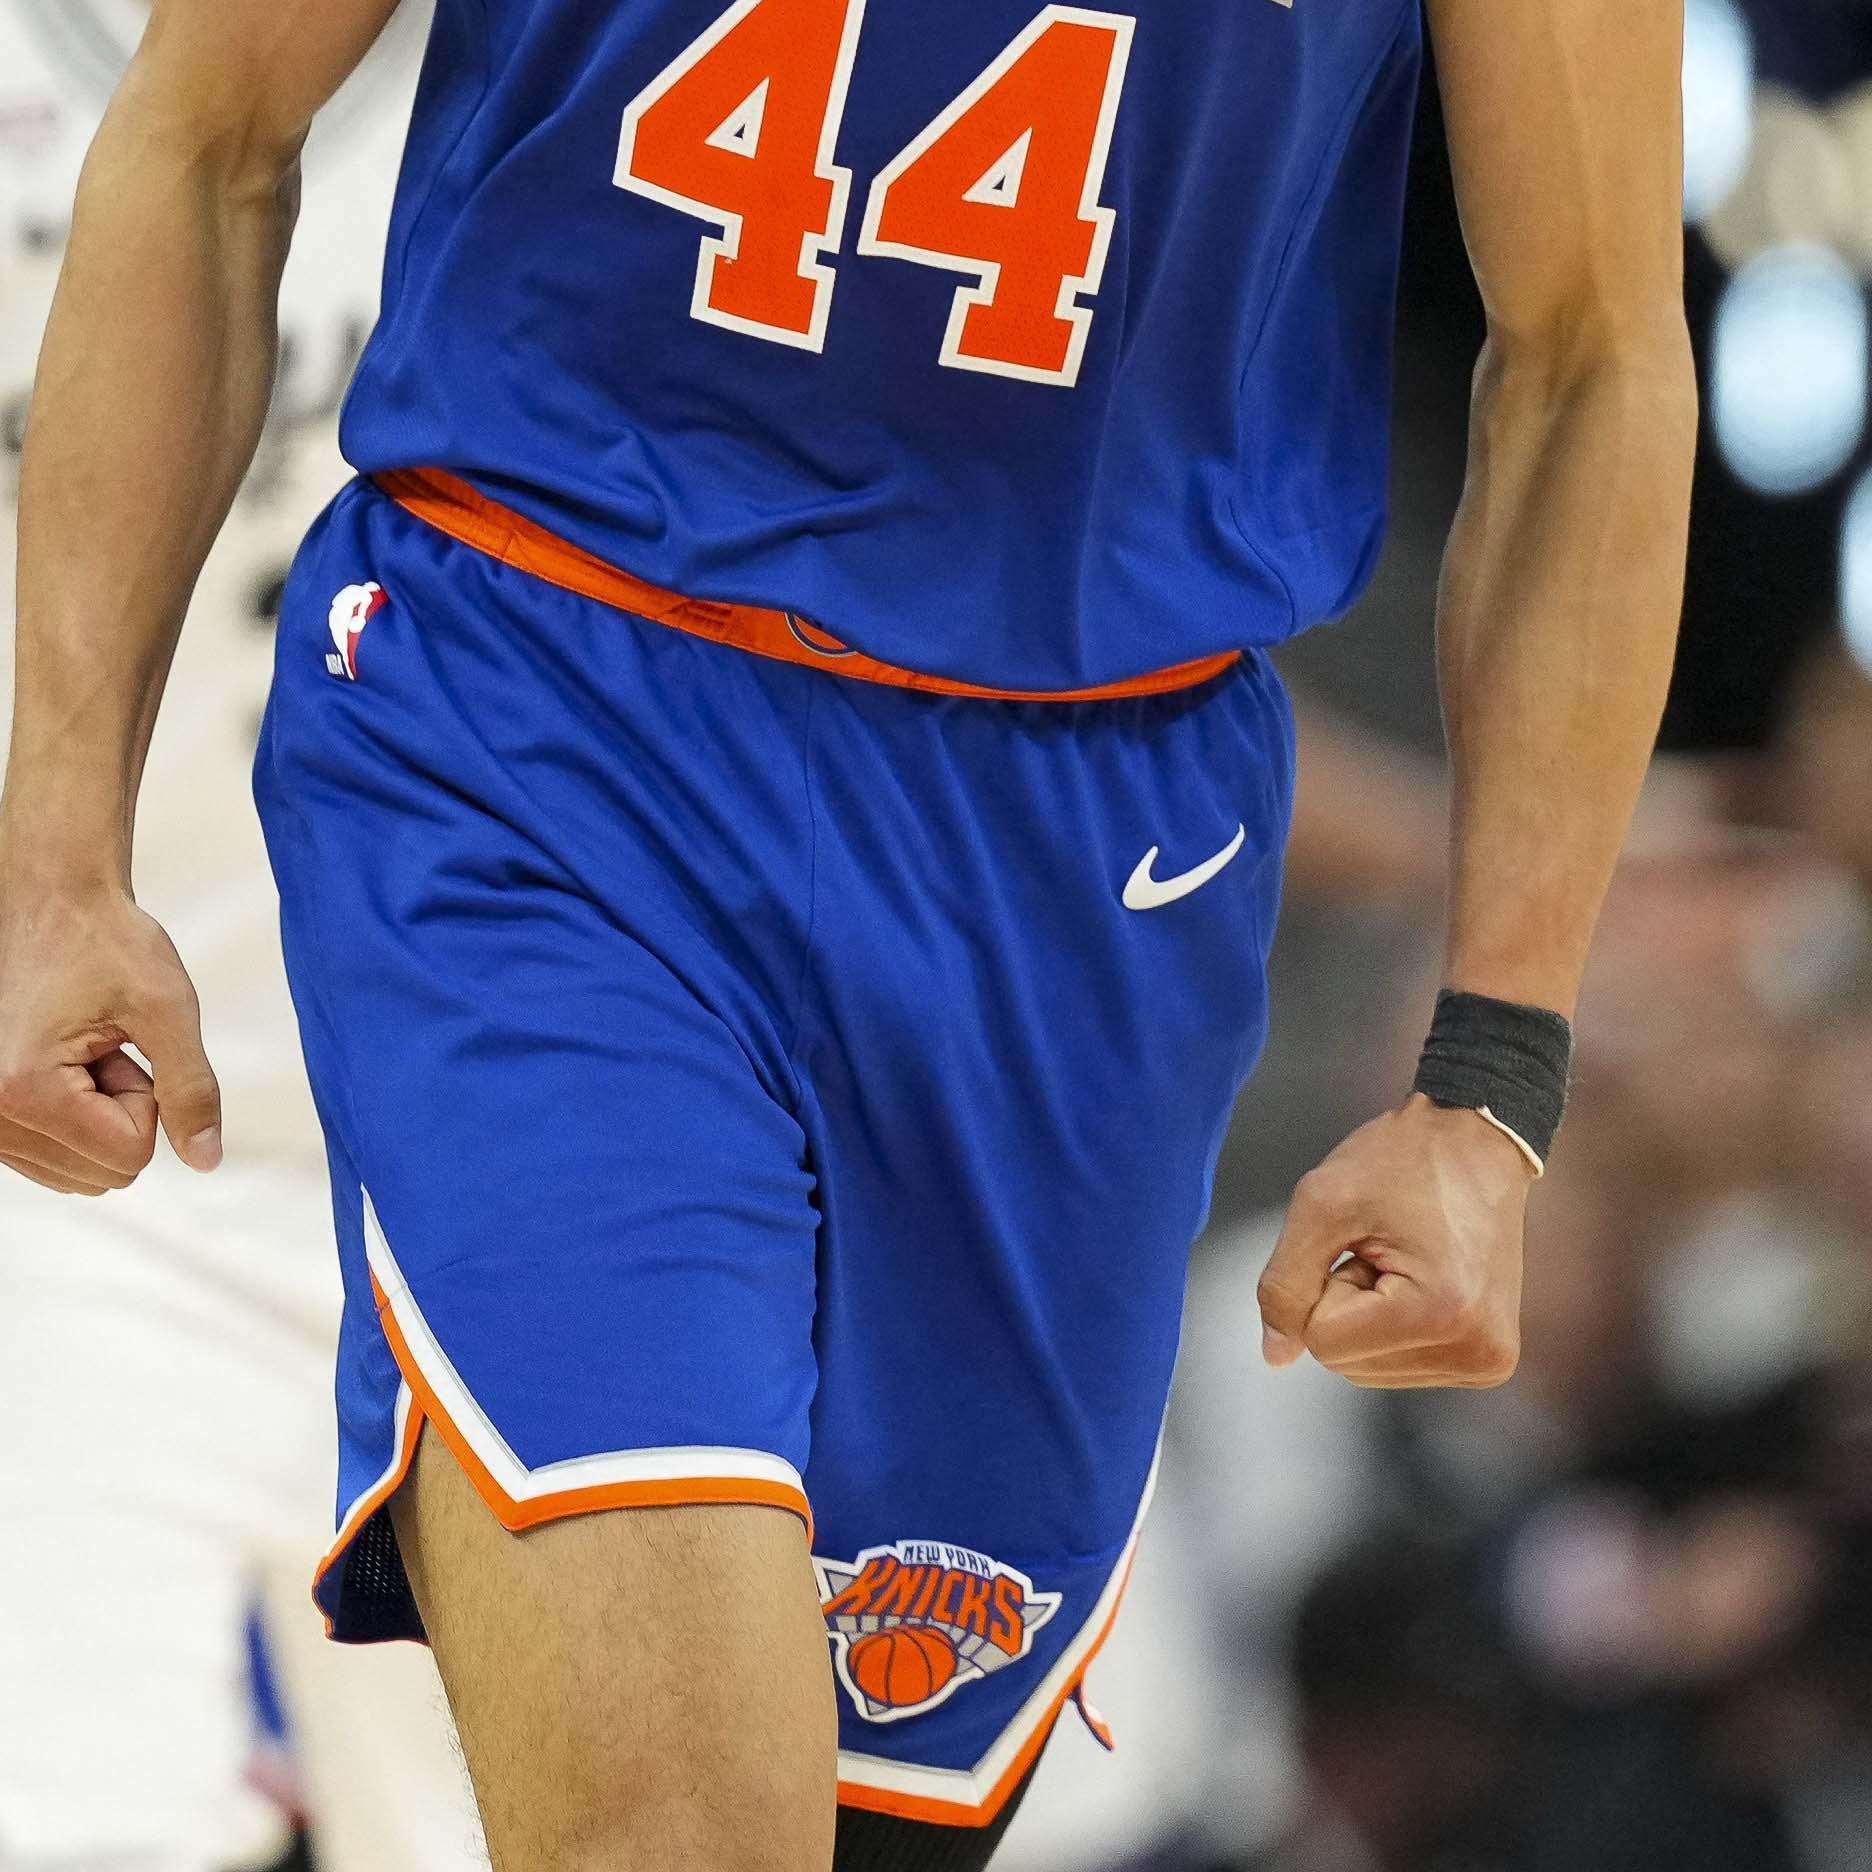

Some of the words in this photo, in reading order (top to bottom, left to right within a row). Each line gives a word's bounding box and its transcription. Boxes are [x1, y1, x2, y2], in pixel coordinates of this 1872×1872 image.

[903, 1544, 941, 1563] NEW
[944, 1546, 991, 1577] YORK
[823, 1555, 1025, 1657] KNICKS
